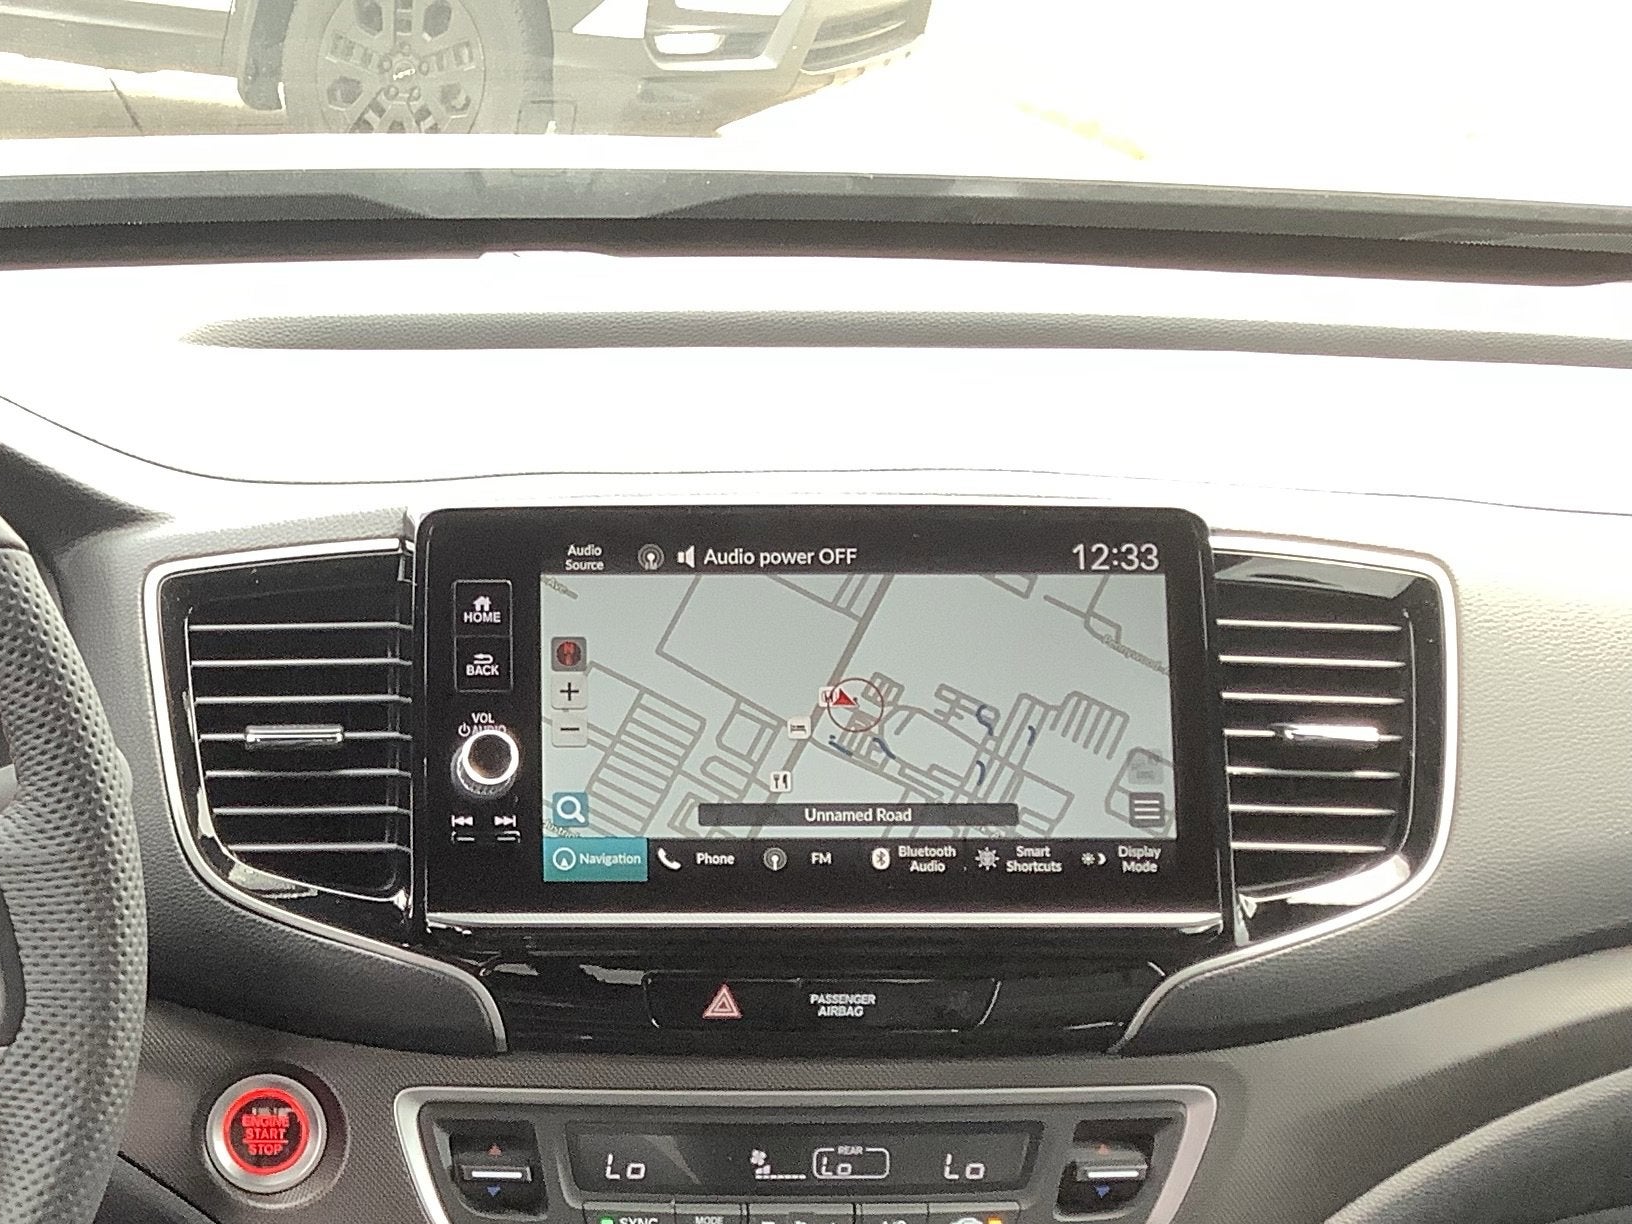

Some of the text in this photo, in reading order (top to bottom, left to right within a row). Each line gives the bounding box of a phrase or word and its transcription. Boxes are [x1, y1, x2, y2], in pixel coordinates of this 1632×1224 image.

[567, 544, 603, 558] Audio
[1071, 542, 1161, 571] 12:33
[565, 558, 605, 571] Source
[703, 548, 858, 570] Audio power OFF
[463, 611, 502, 624] HOME
[466, 665, 500, 676] BACK
[471, 712, 495, 724] VOL
[804, 807, 913, 823] Unnamed Road
[897, 845, 957, 859] Bluetooth
[1015, 845, 1051, 858] Smart
[1118, 845, 1162, 860] Display
[579, 852, 642, 867] Navigation
[696, 852, 735, 866] Phone
[811, 852, 832, 865] FM
[909, 860, 946, 873] Audio
[1006, 860, 1062, 873] Shortcuts
[1122, 860, 1158, 873] Mode
[810, 993, 877, 1005] PASSENGER
[818, 1006, 864, 1018] AIRBAG
[241, 1114, 290, 1127] ENGINE
[245, 1128, 287, 1140] START
[248, 1143, 284, 1155] STOP
